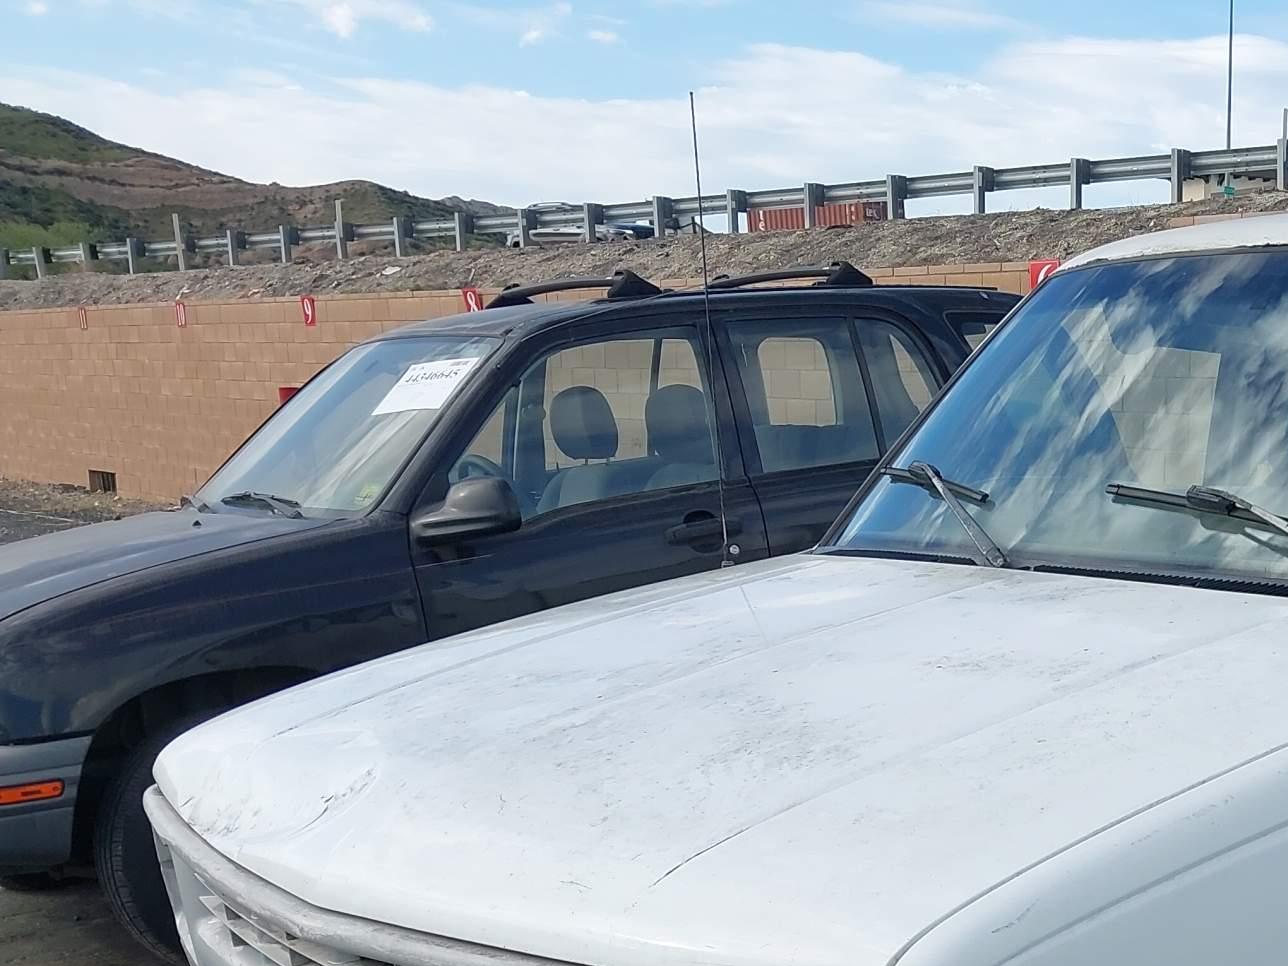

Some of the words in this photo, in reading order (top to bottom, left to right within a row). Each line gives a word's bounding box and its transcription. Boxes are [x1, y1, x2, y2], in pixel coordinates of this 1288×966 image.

[303, 298, 313, 324] 9
[466, 291, 479, 312] 8
[80, 308, 87, 329] 11
[175, 303, 186, 326] 10
